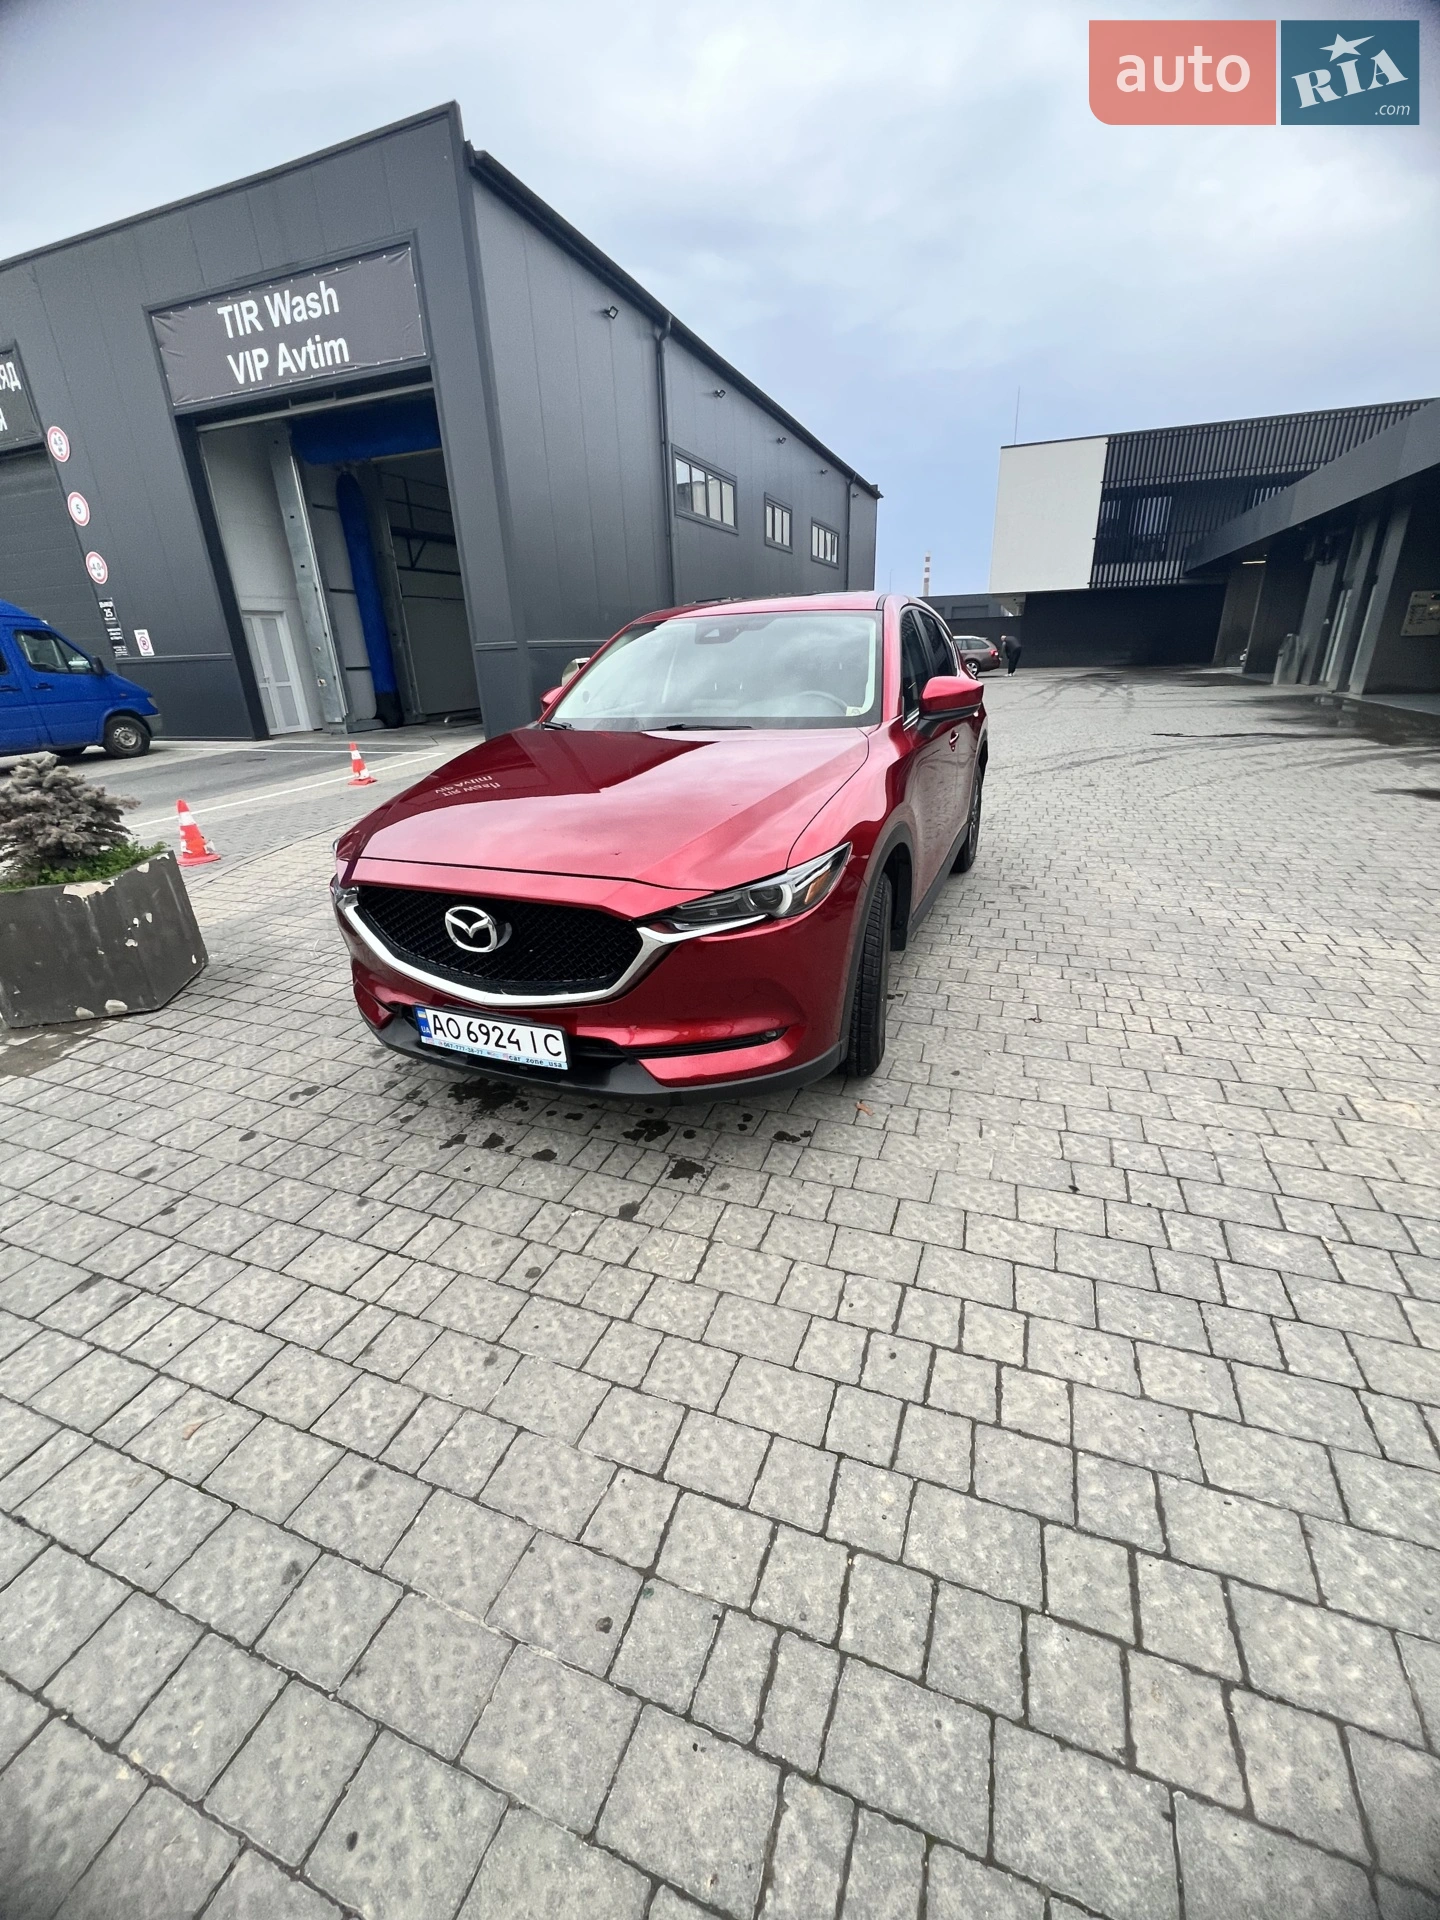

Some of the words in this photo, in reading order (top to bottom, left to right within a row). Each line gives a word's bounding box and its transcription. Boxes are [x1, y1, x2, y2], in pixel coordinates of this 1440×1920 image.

[217, 299, 264, 338] TIR
[263, 280, 340, 328] Wash
[227, 347, 270, 385] VIP
[277, 335, 349, 377] Avtim
[76, 504, 82, 515] 5
[421, 1026, 431, 1034] UA
[433, 1014, 461, 1040] AO
[466, 1021, 522, 1051] 6924
[530, 1031, 562, 1057] IC
